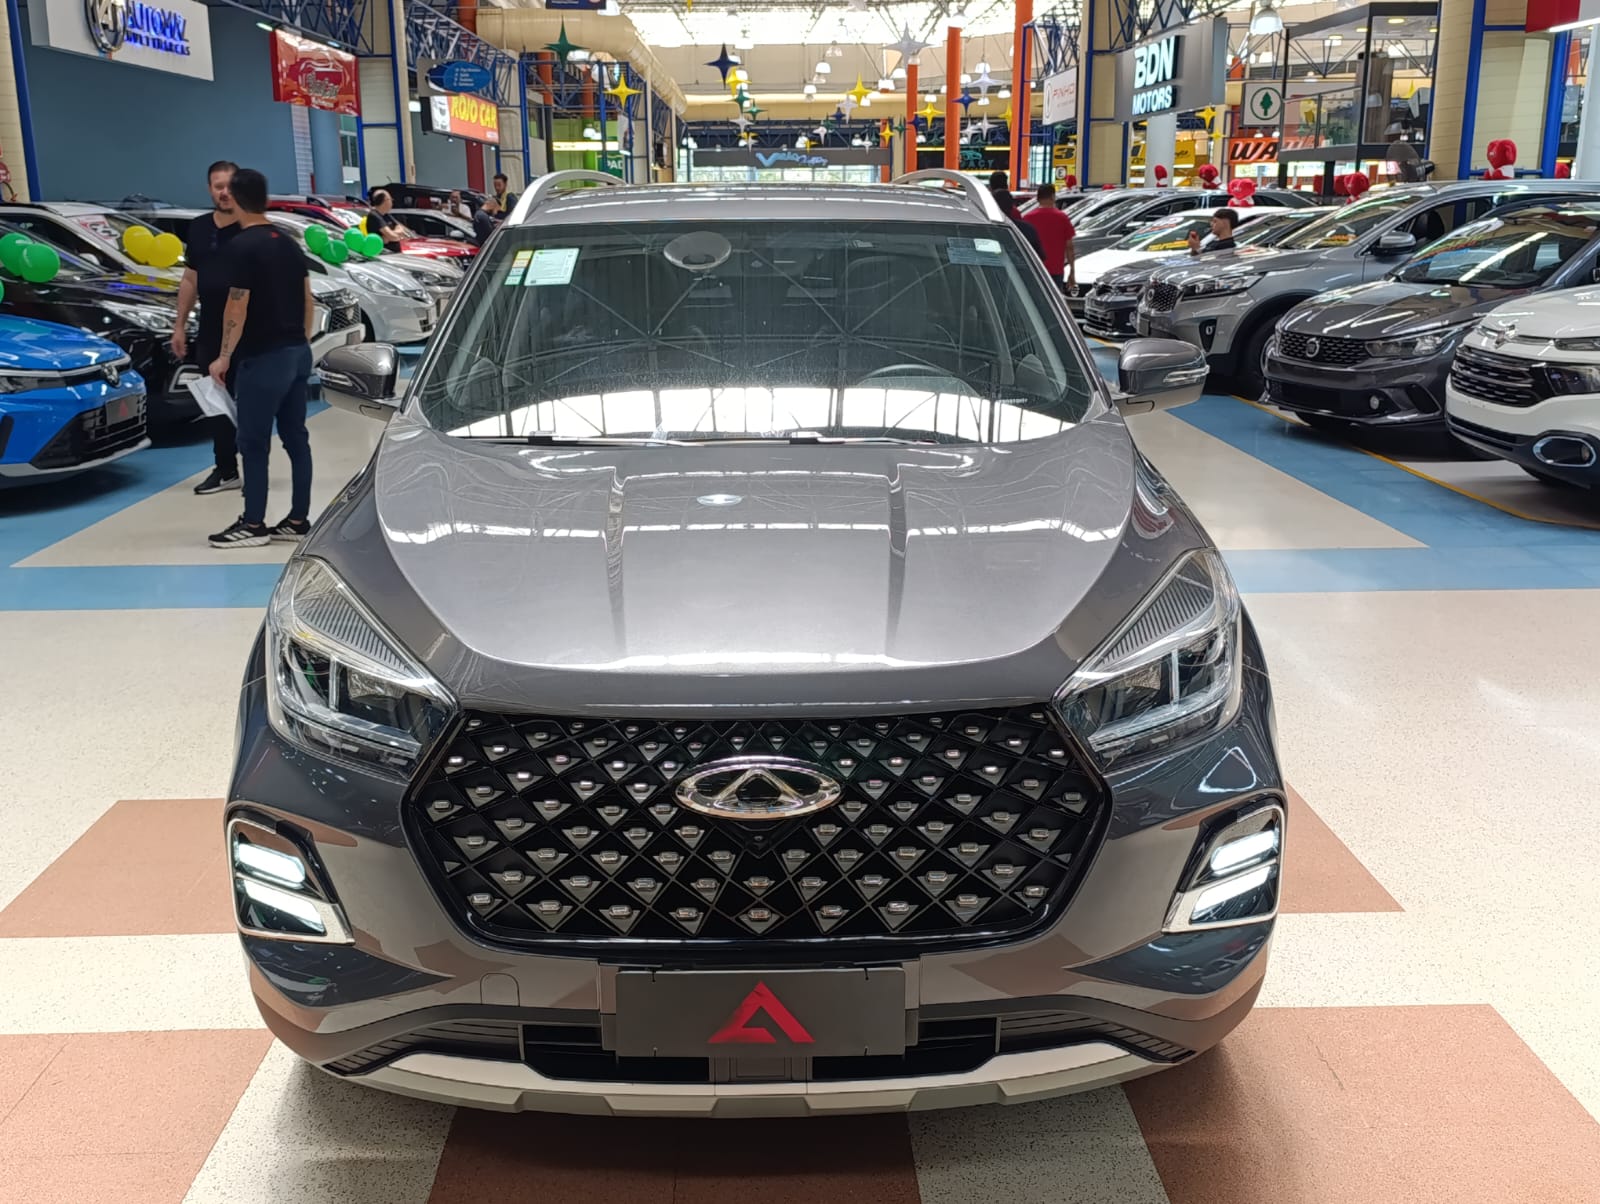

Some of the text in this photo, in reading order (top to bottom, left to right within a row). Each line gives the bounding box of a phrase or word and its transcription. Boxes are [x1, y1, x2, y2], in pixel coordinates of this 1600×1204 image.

[1134, 35, 1175, 89] BDN
[451, 95, 478, 124] ROJO
[480, 103, 497, 129] CAR
[1132, 85, 1173, 116] MOTORS
